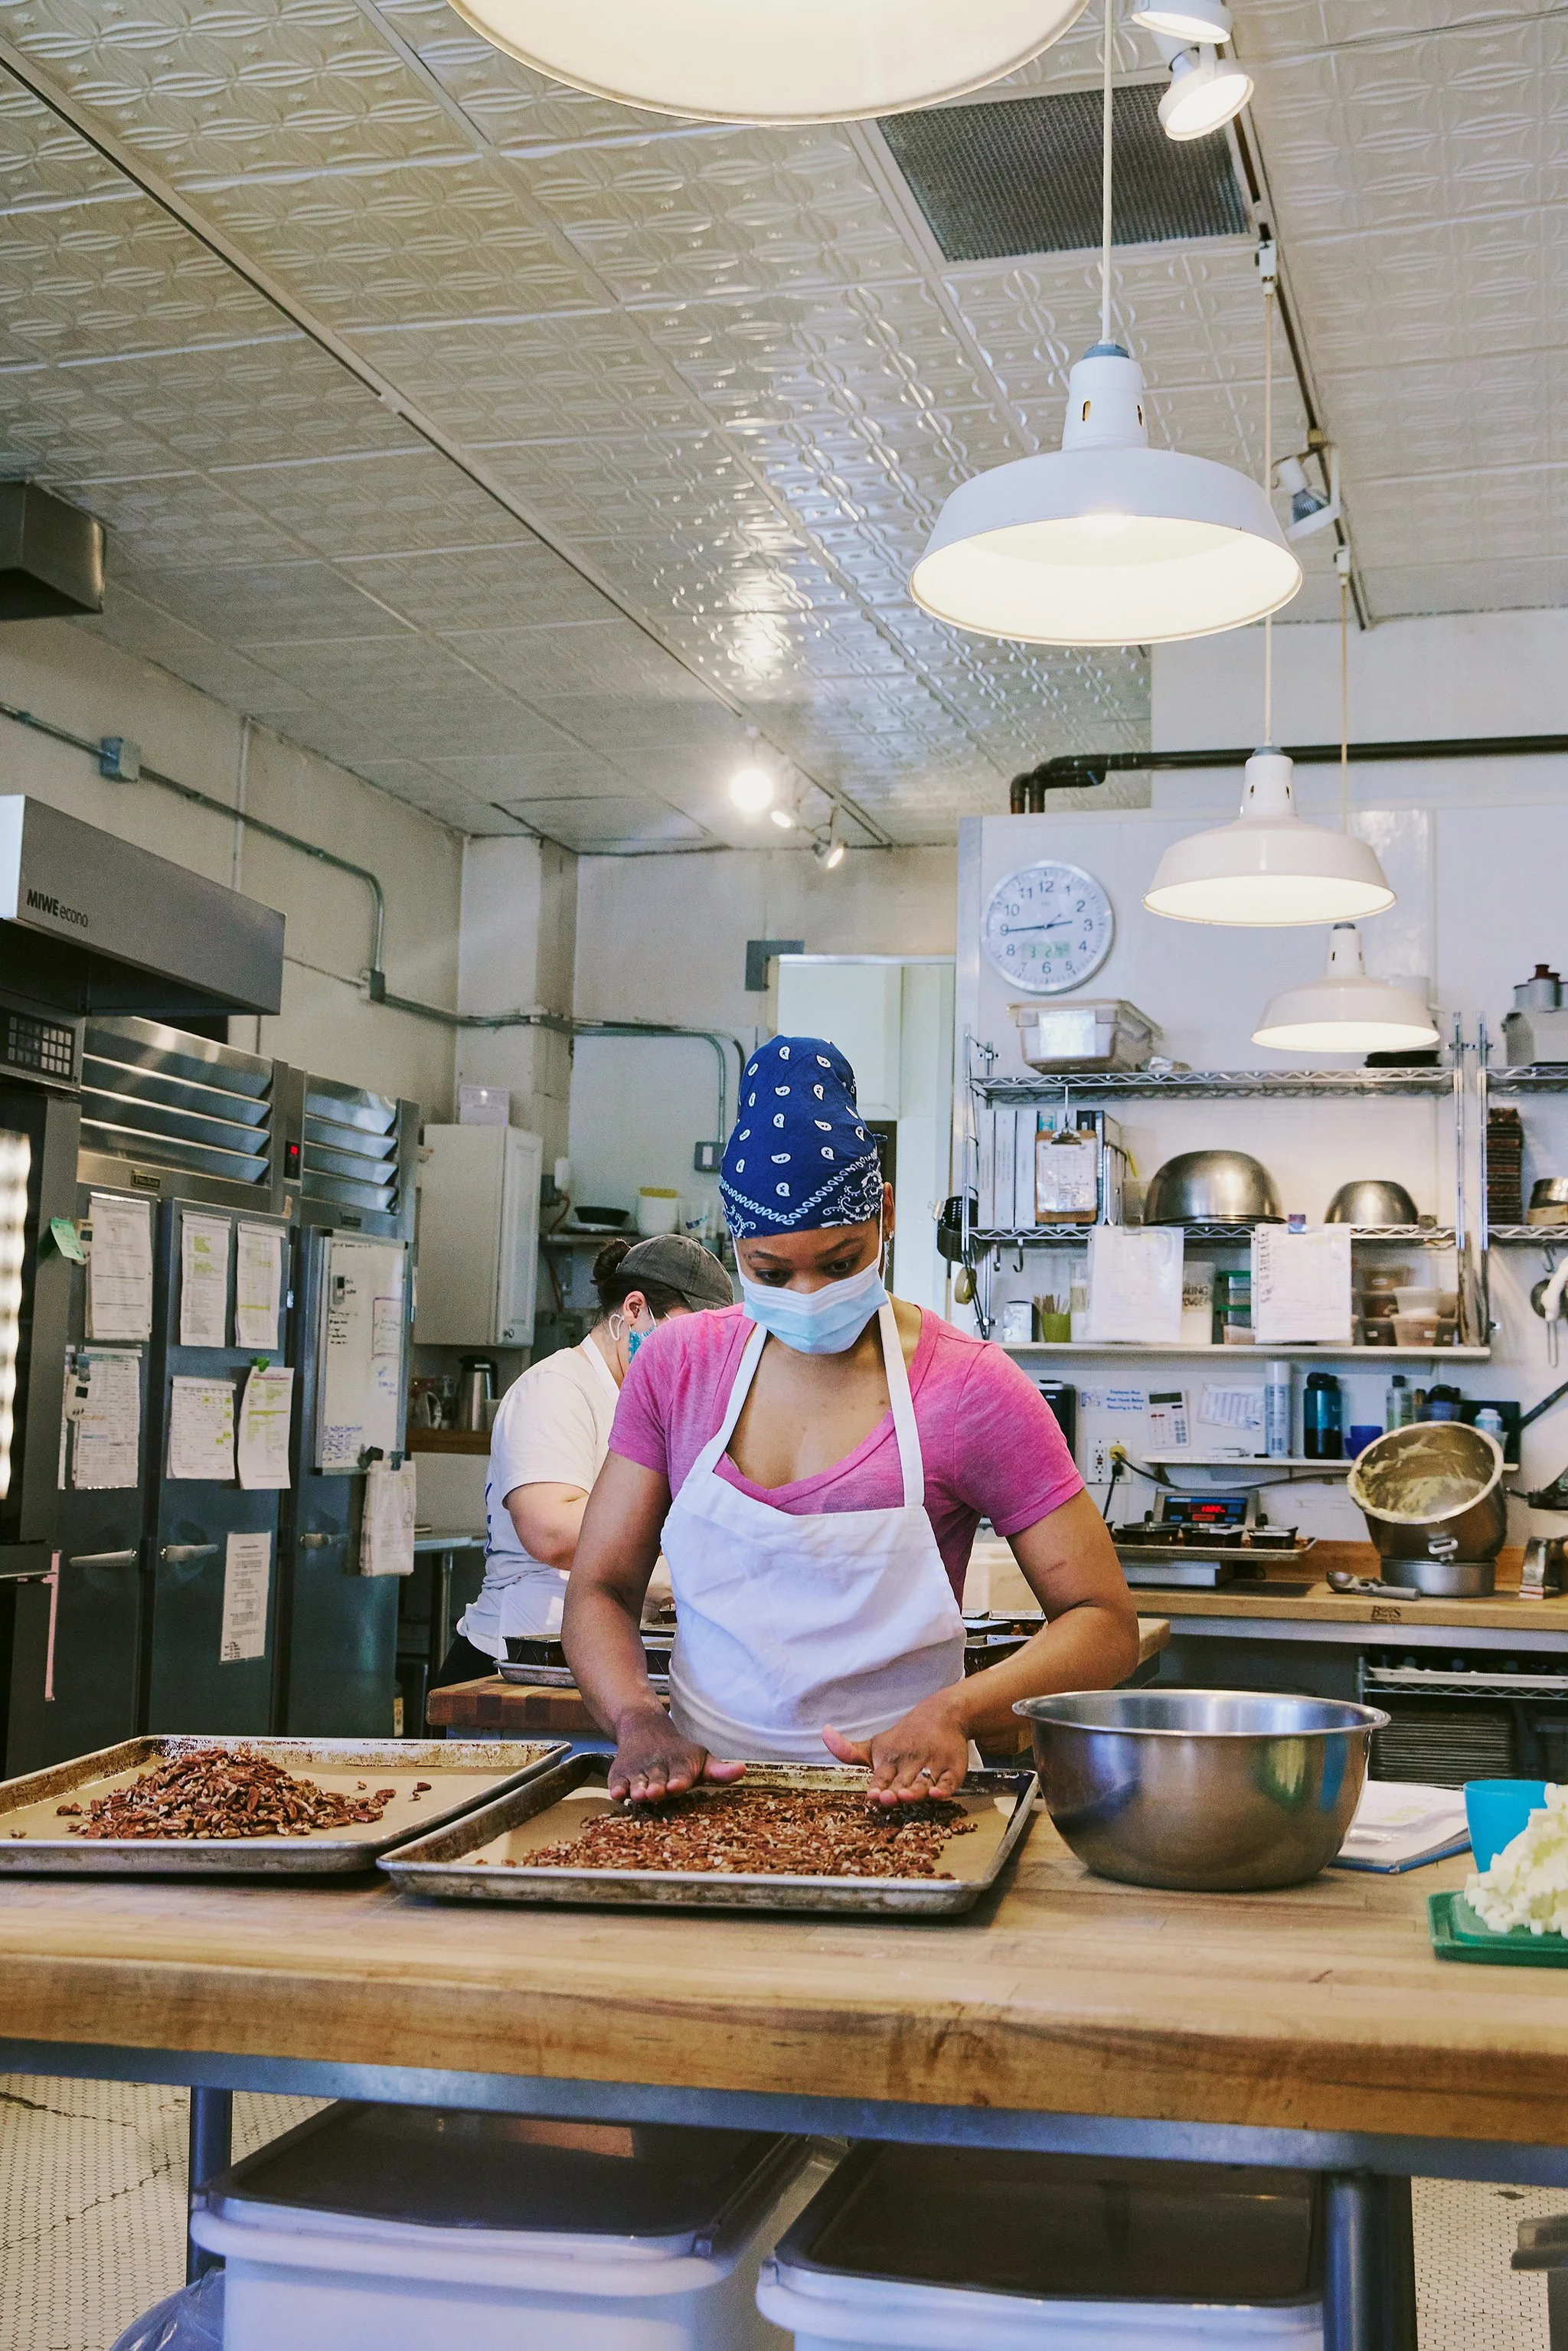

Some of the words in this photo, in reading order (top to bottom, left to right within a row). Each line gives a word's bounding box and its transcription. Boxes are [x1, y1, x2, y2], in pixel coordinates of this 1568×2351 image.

[1039, 881, 1054, 893] 12
[1065, 885, 1070, 896] 1
[1020, 888, 1033, 899] 11
[27, 889, 60, 916] MIWE
[60, 905, 89, 927] econo
[1004, 903, 1020, 916] 10
[1076, 900, 1086, 913] 2
[1000, 923, 1009, 936] 9
[1083, 919, 1093, 932] 3
[1006, 943, 1015, 956] 8
[1078, 940, 1087, 952] 4
[1021, 962, 1027, 972] 7
[1042, 962, 1051, 974] 6
[1065, 960, 1073, 971] 5
